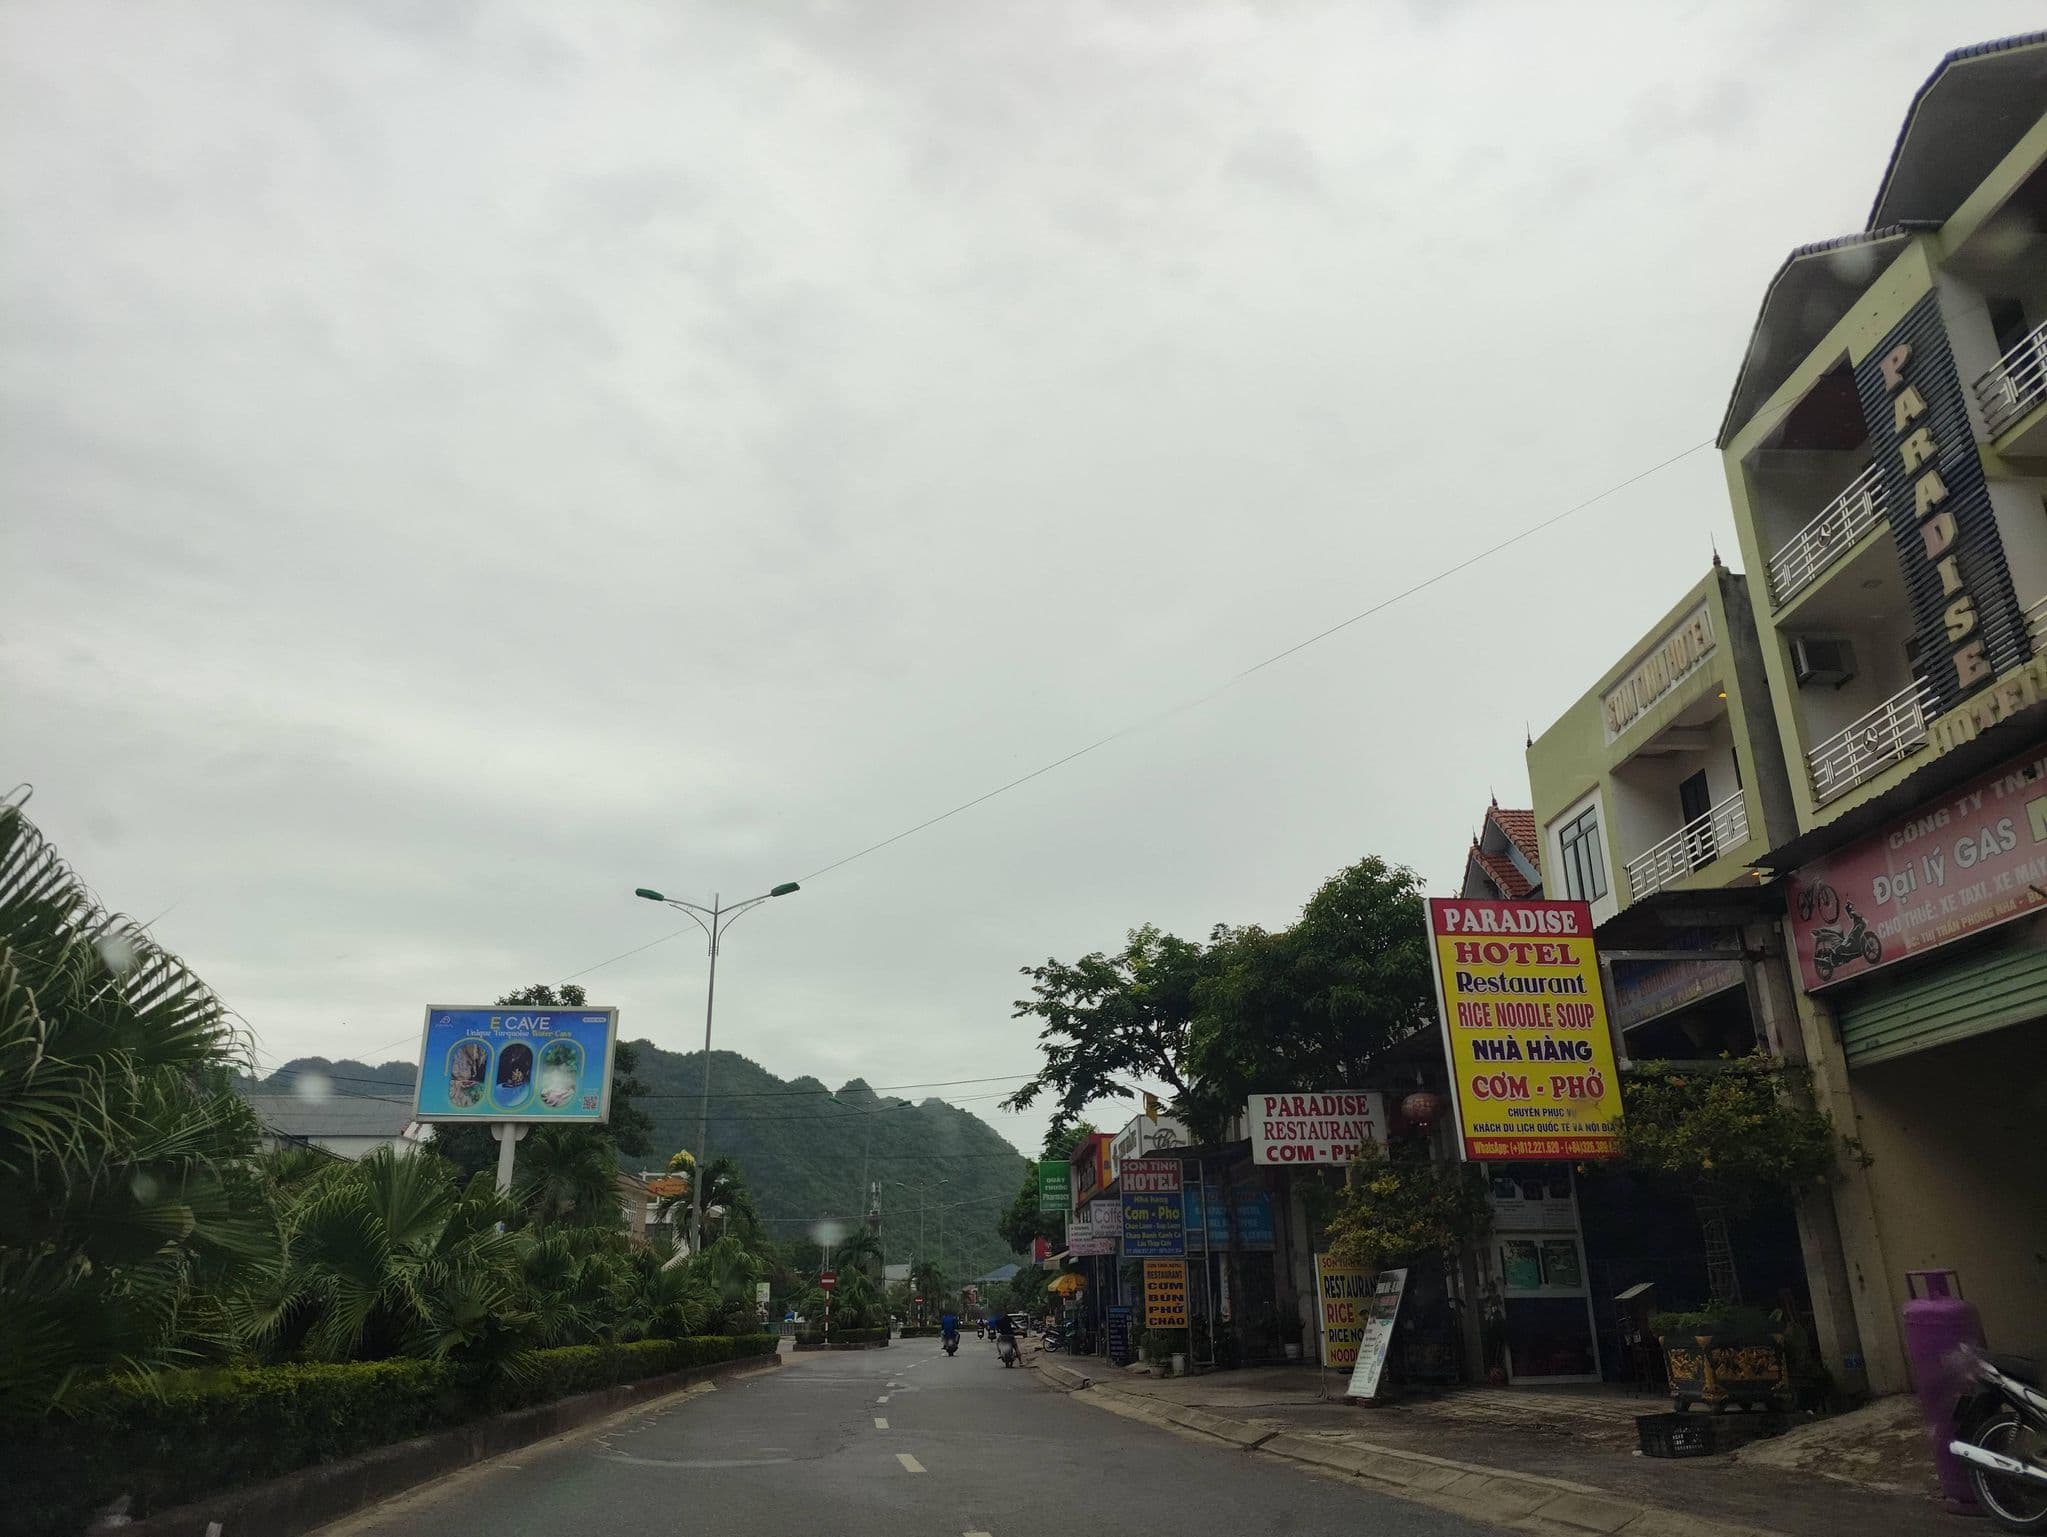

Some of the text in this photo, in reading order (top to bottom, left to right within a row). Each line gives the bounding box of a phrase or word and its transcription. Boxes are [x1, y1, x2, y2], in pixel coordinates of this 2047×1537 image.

[1880, 342, 1992, 689] PARADISE
[1888, 808, 1950, 849] CÔNG
[1955, 789, 1984, 818] TY
[1872, 862, 1917, 905] Đại
[1921, 846, 1946, 887] lý
[1954, 817, 2017, 869] GAS
[1443, 908, 1579, 935] PARADISE
[1877, 915, 1902, 940] CHO
[1454, 941, 1580, 965] HOTEL
[1455, 971, 1587, 994] Restaurant
[490, 1016, 550, 1030] E CAVE
[1457, 1002, 1595, 1029] RICE NOODLE SOUP
[466, 1029, 491, 1038] Unique
[1472, 1035, 1593, 1061] NHÀ HÀNG
[1472, 1072, 1530, 1099] CƠM
[1550, 1067, 1604, 1099] PHỞ
[1264, 1095, 1370, 1117] PARADISE
[1264, 1119, 1375, 1141] RESTAURANT
[1266, 1145, 1315, 1162] CƠM
[1122, 1173, 1179, 1191] HOTEL
[1327, 1302, 1355, 1324] RICE
[1329, 1328, 1348, 1343] RICE
